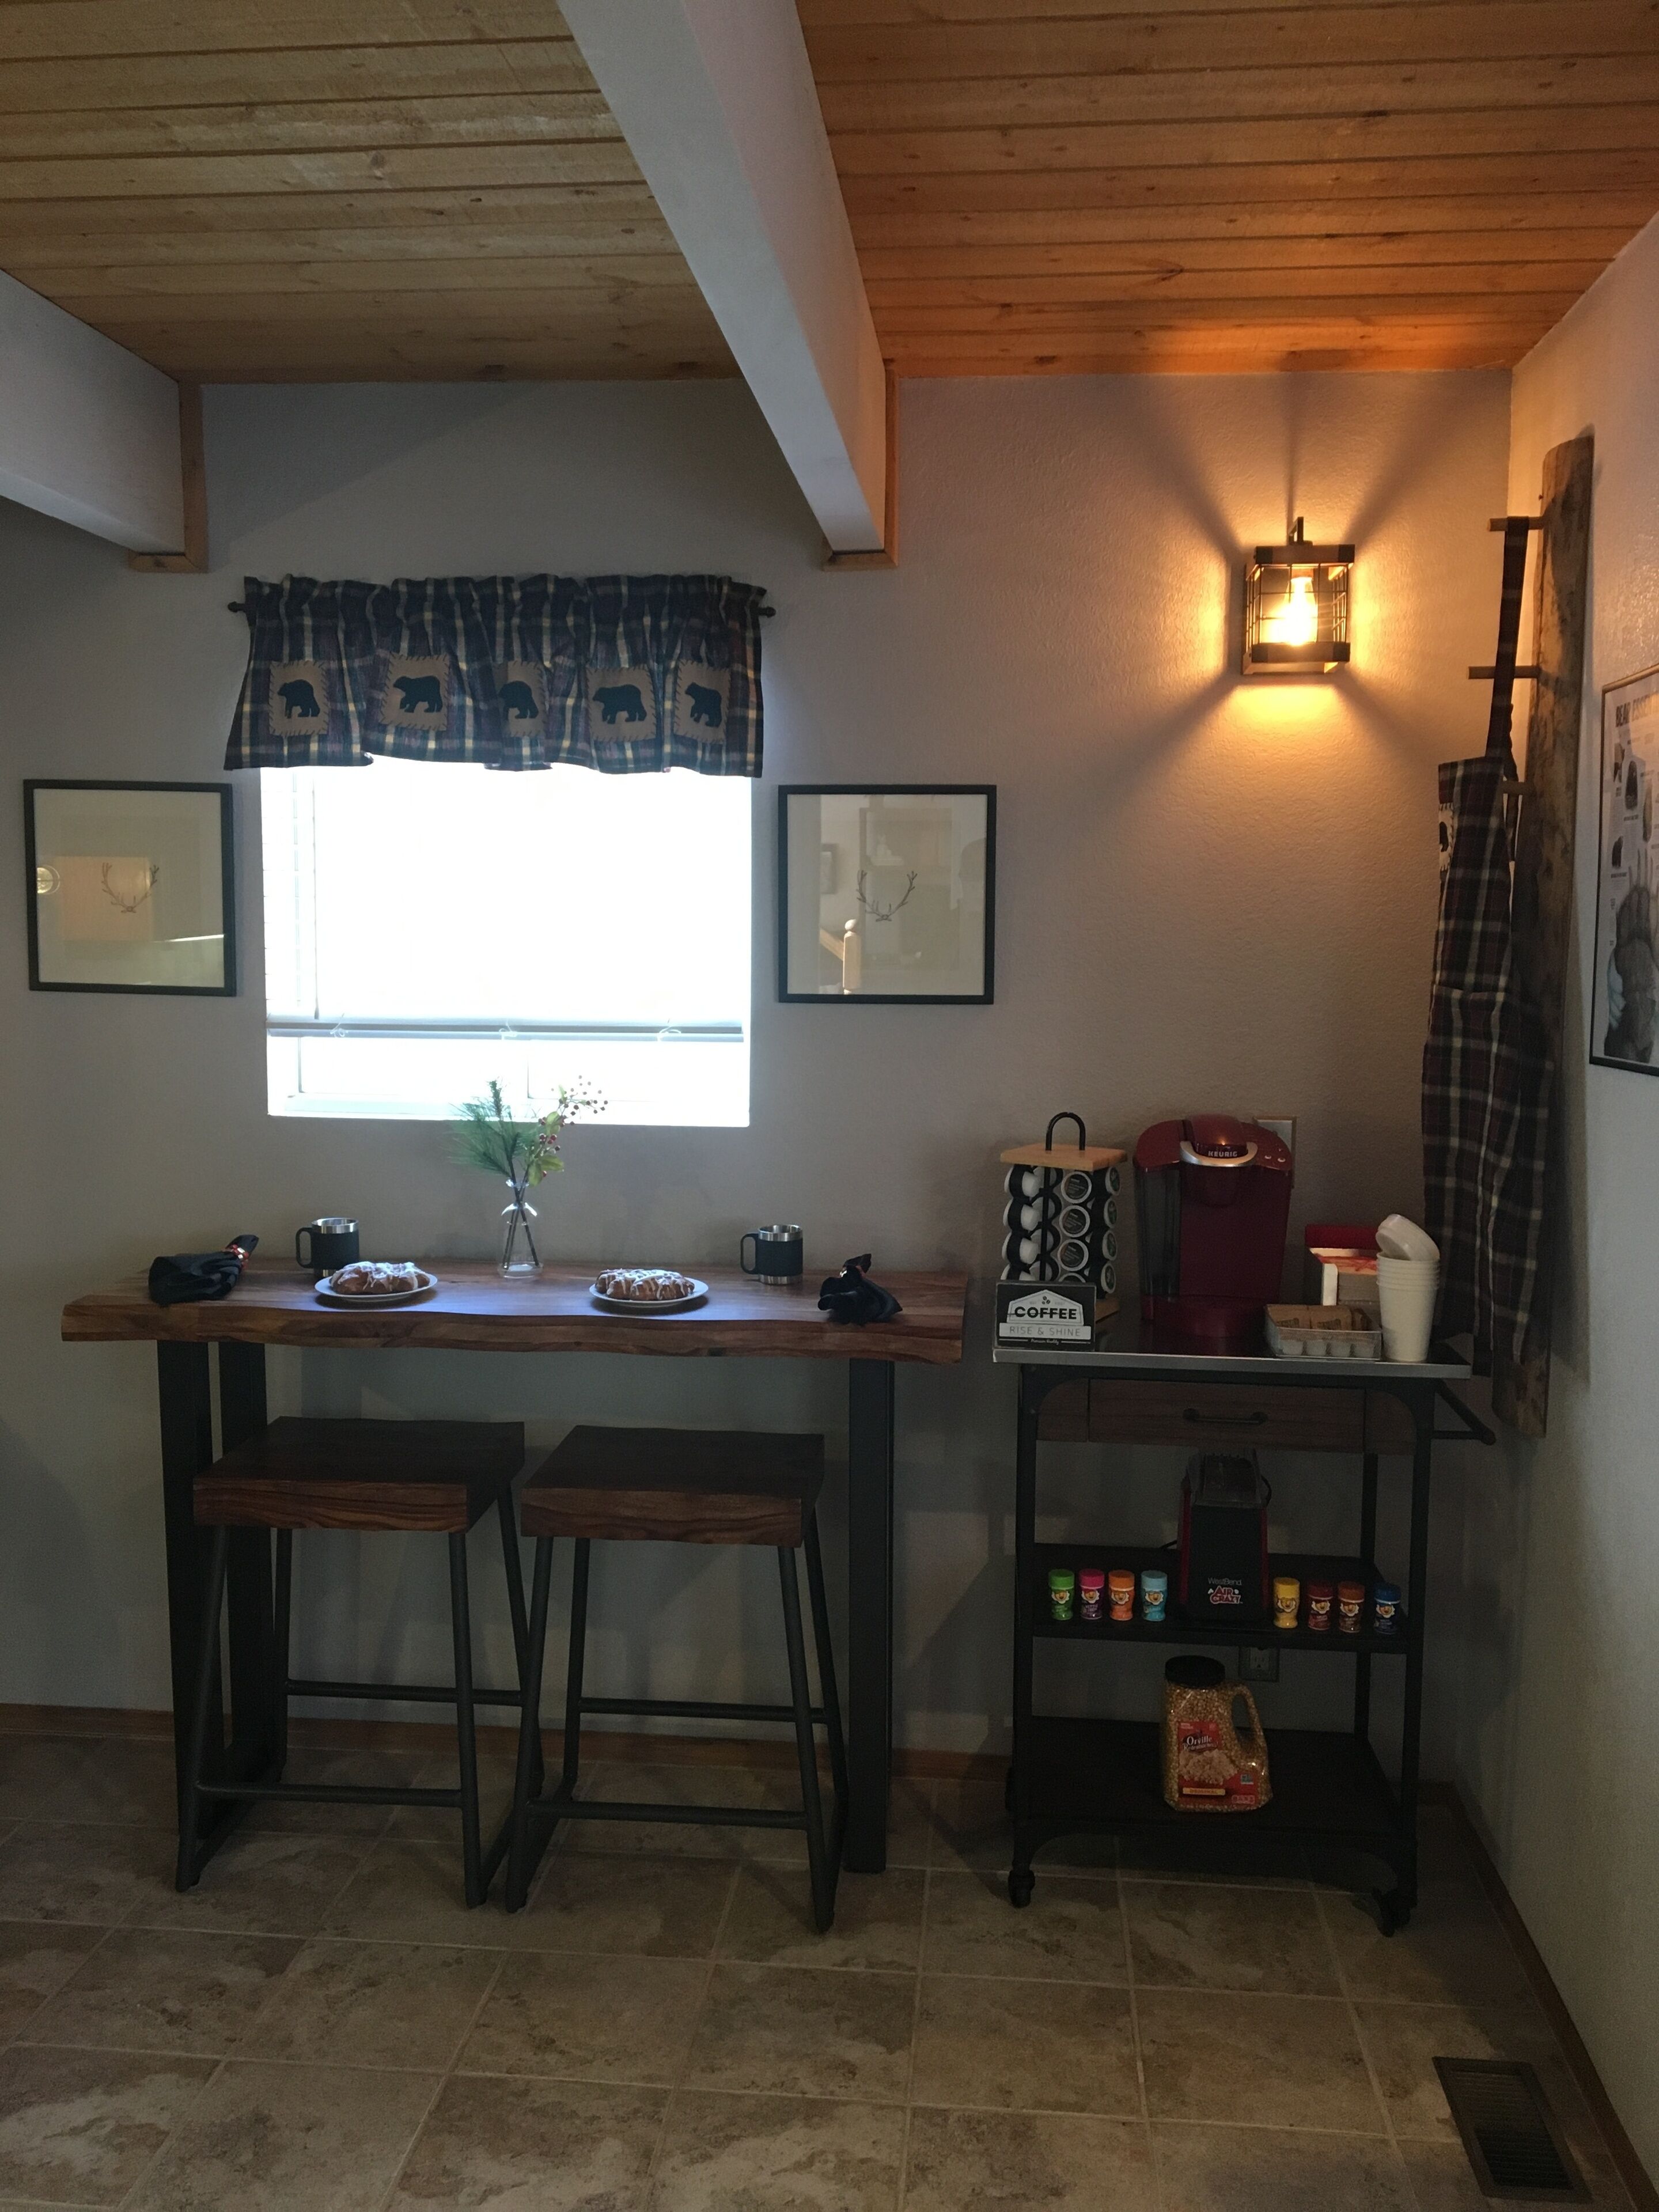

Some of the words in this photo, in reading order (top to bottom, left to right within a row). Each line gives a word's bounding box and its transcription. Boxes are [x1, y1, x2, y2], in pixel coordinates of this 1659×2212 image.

[1014, 1306, 1077, 1320] COFFEE
[1009, 1326, 1032, 1335] RISE
[1037, 1327, 1044, 1335] &
[1050, 1327, 1081, 1336] SHINE
[1187, 1735, 1213, 1745] Orville
